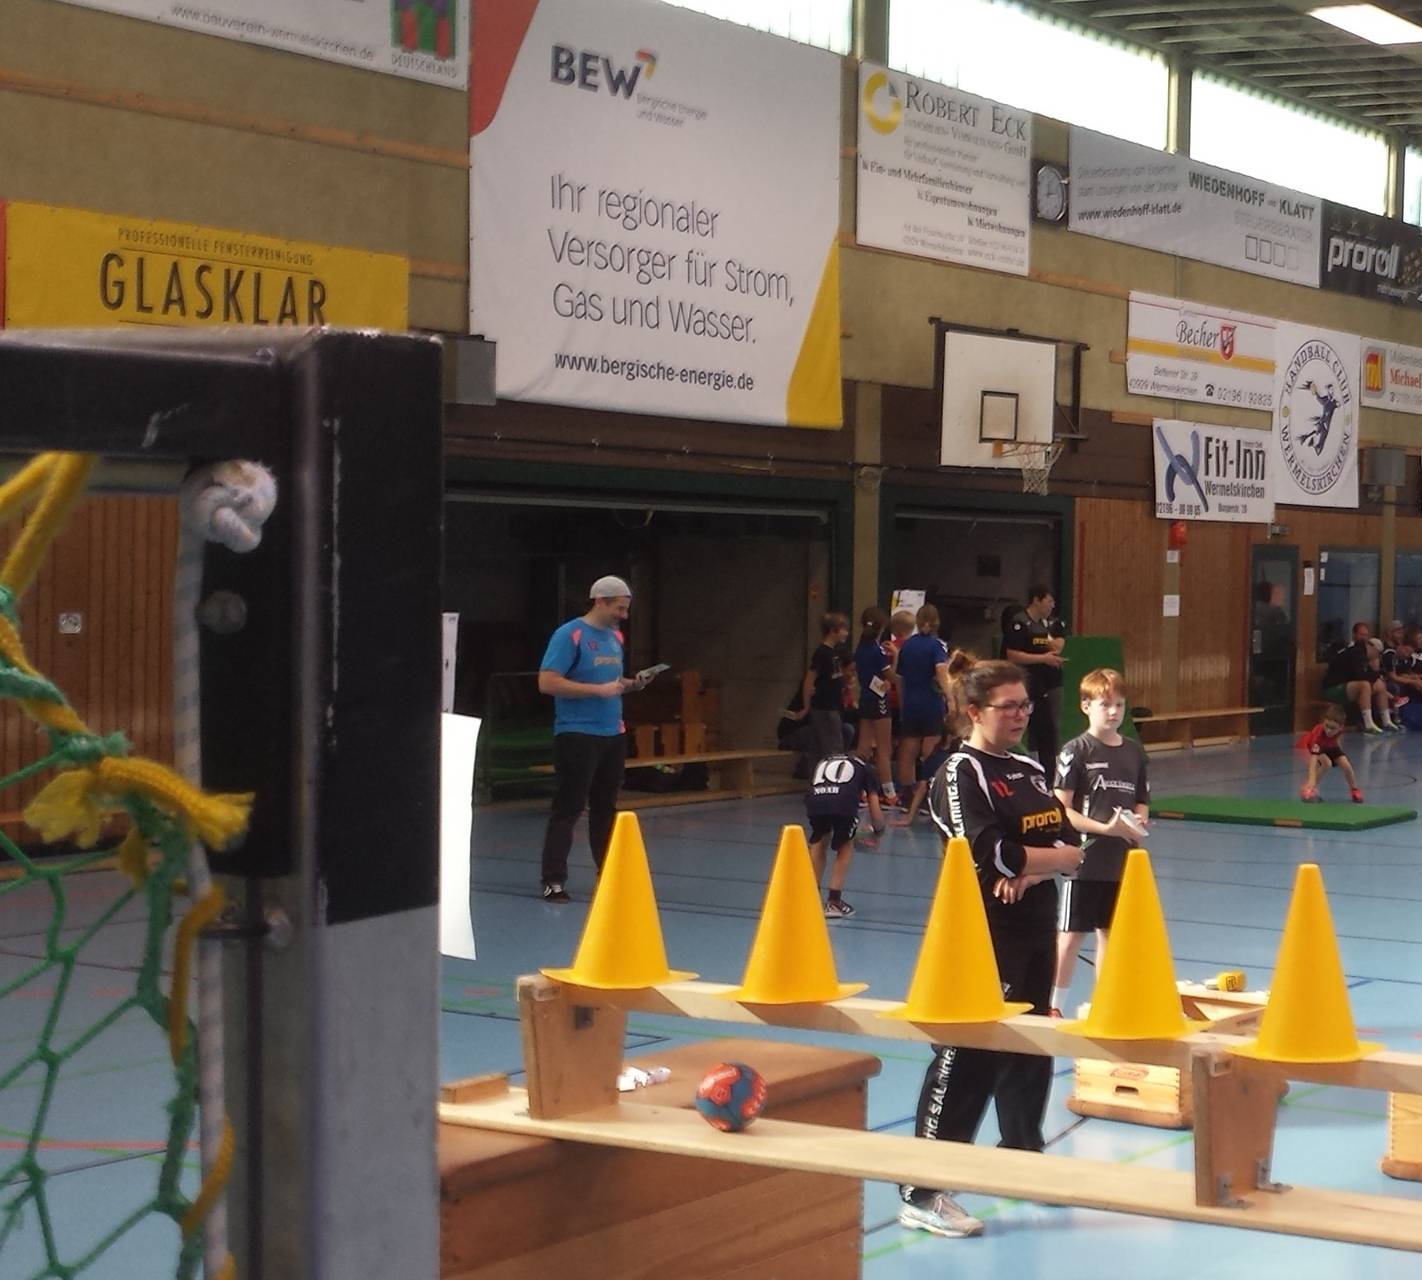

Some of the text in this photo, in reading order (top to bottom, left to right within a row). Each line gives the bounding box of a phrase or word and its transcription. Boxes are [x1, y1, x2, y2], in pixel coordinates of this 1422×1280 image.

[550, 45, 642, 100] BEW
[906, 80, 980, 128] ROBERT
[991, 105, 1027, 141] ECK
[551, 174, 721, 239] Ihr regionaler
[1188, 171, 1265, 206] WIEDENHOFF
[1279, 199, 1315, 221] KLATT
[547, 229, 796, 307] Versorger für Strom,
[1327, 236, 1400, 280] proroll
[100, 251, 327, 327] GLASKLAR
[553, 282, 757, 345] Gas und Wasser.
[1175, 319, 1220, 348] Becher
[554, 351, 755, 391] www.bergische-energie.de
[1285, 344, 1331, 396] HANDBALL
[1390, 367, 1422, 389] Michael
[1204, 436, 1266, 481] Fit-Inn
[1280, 424, 1351, 491] WERMELSKIRCHEN
[1204, 480, 1265, 499] Wermelskirchen
[812, 759, 855, 786] 10
[813, 786, 840, 796] NOAH
